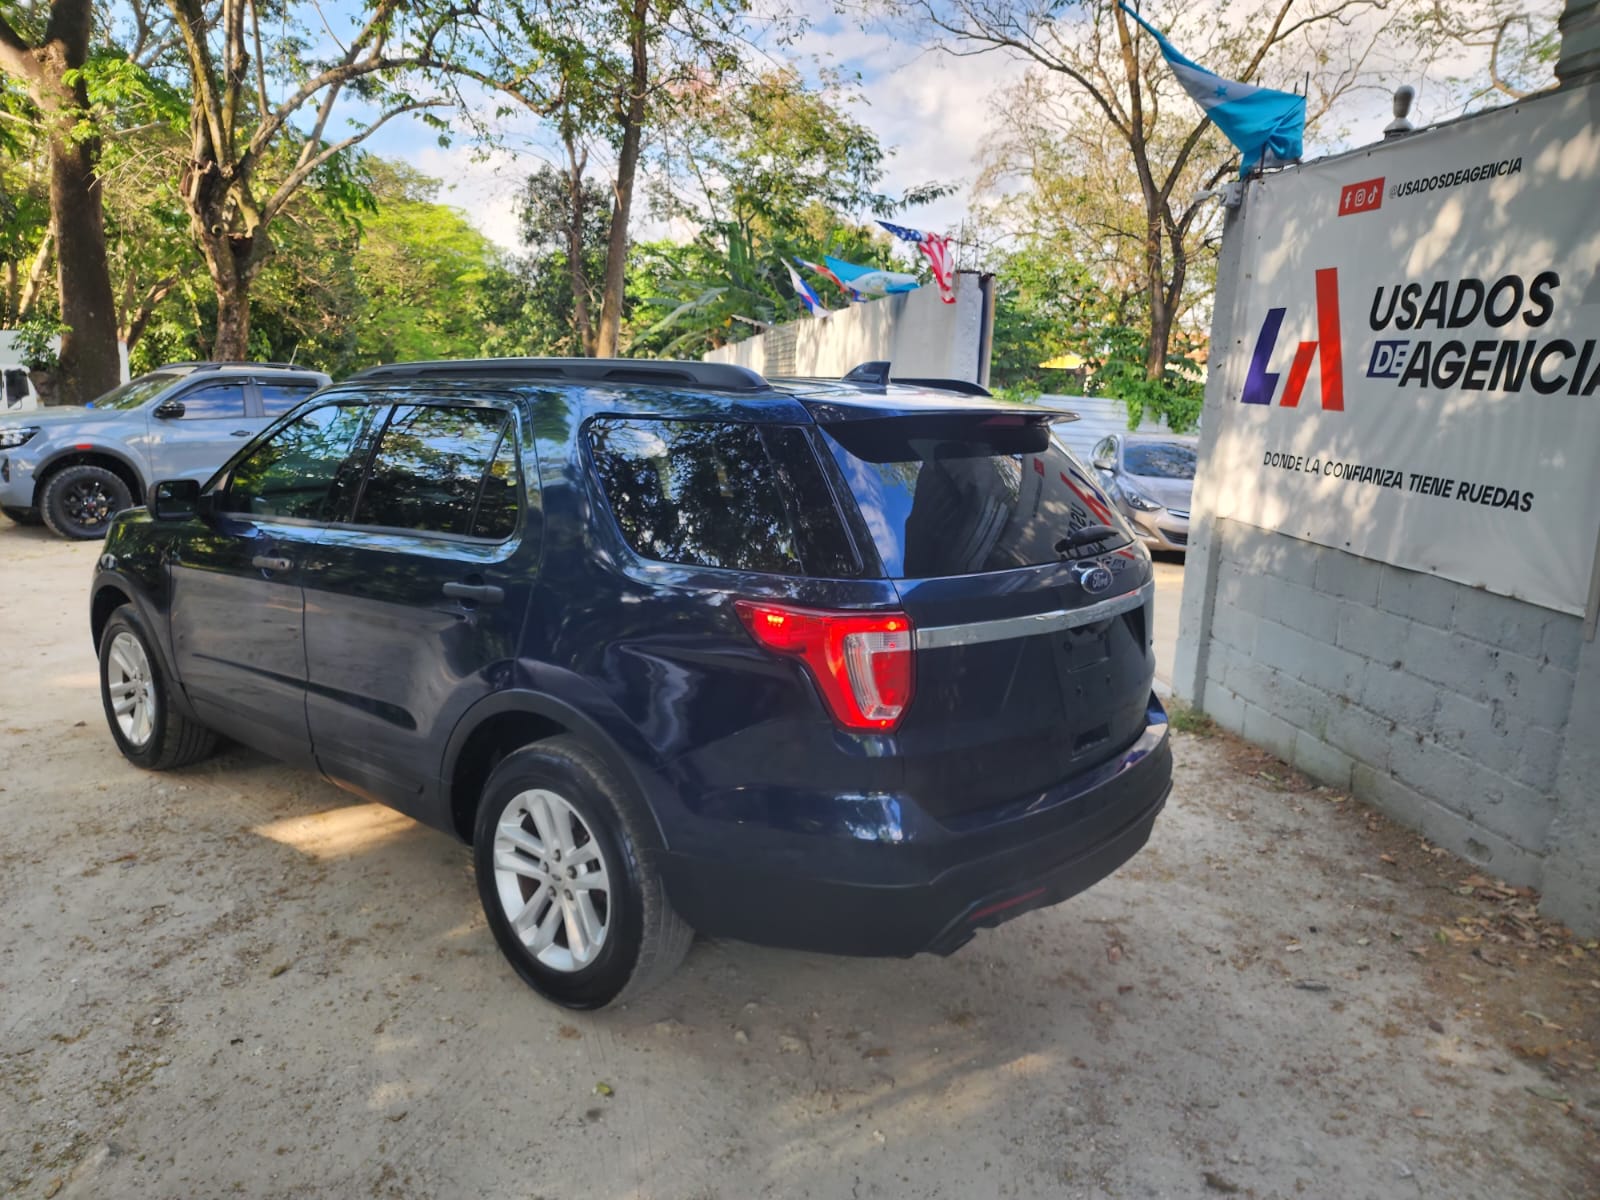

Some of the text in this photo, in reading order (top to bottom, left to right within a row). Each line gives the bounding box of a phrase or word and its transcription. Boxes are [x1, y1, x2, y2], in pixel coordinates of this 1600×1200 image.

[1389, 157, 1522, 199] @USADOSDEAGENCIA
[1369, 271, 1561, 331] USADOS
[1263, 451, 1535, 513] DONDE LA CONFIANZA TIENE RUEDAS
